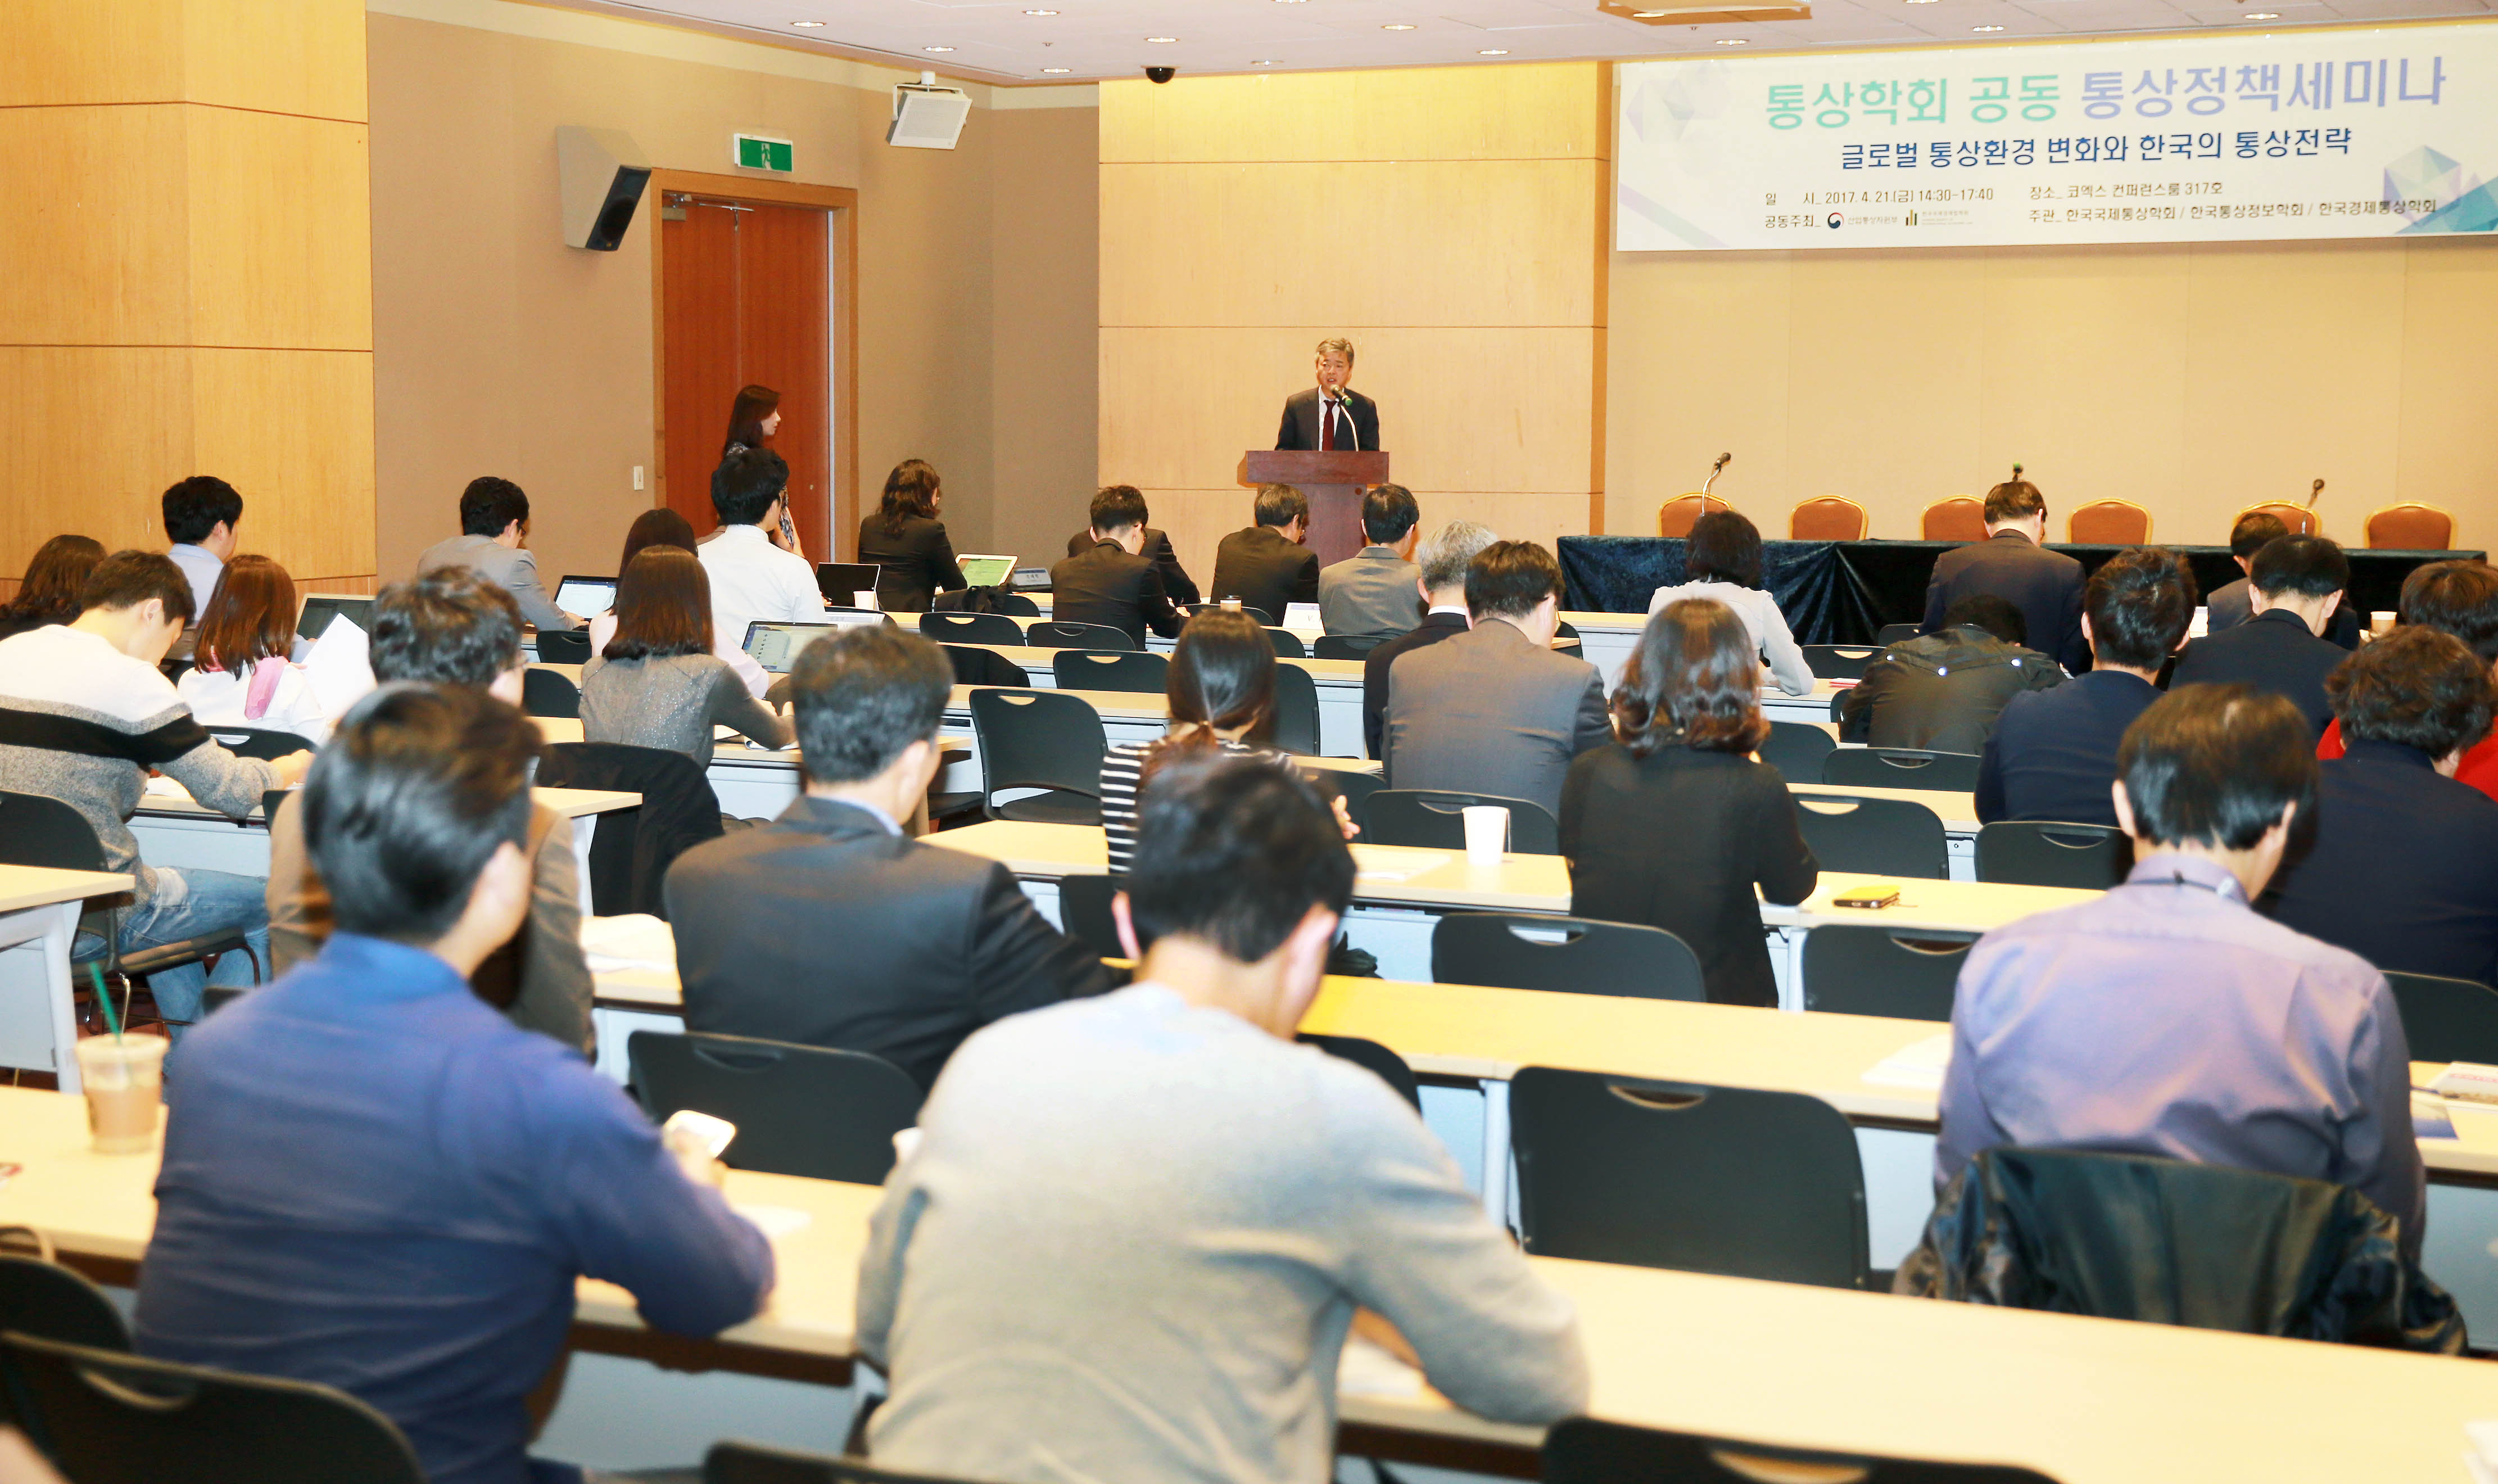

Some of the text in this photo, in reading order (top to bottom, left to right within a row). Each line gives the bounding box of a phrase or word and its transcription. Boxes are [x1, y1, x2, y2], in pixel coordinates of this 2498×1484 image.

[1767, 55, 2446, 130] 통상학회 공동 통상정책세미나
[1843, 128, 2351, 169] 글로벌 통상환경 변화와 한국의 통상전략
[1766, 193, 1776, 205] 일
[1826, 192, 1858, 203] 2017.
[1862, 191, 1871, 203] 4.
[1920, 188, 1993, 201] 14:30-17:40
[2068, 185, 2106, 198] 코엑스
[2114, 183, 2179, 197] 컨퍼런스룸
[2185, 182, 2221, 195] 317호
[2067, 207, 2175, 221] 한국국제통상학회
[2191, 203, 2303, 219] 한국통상정보학회
[2319, 198, 2437, 215] 한국경제통상학회
